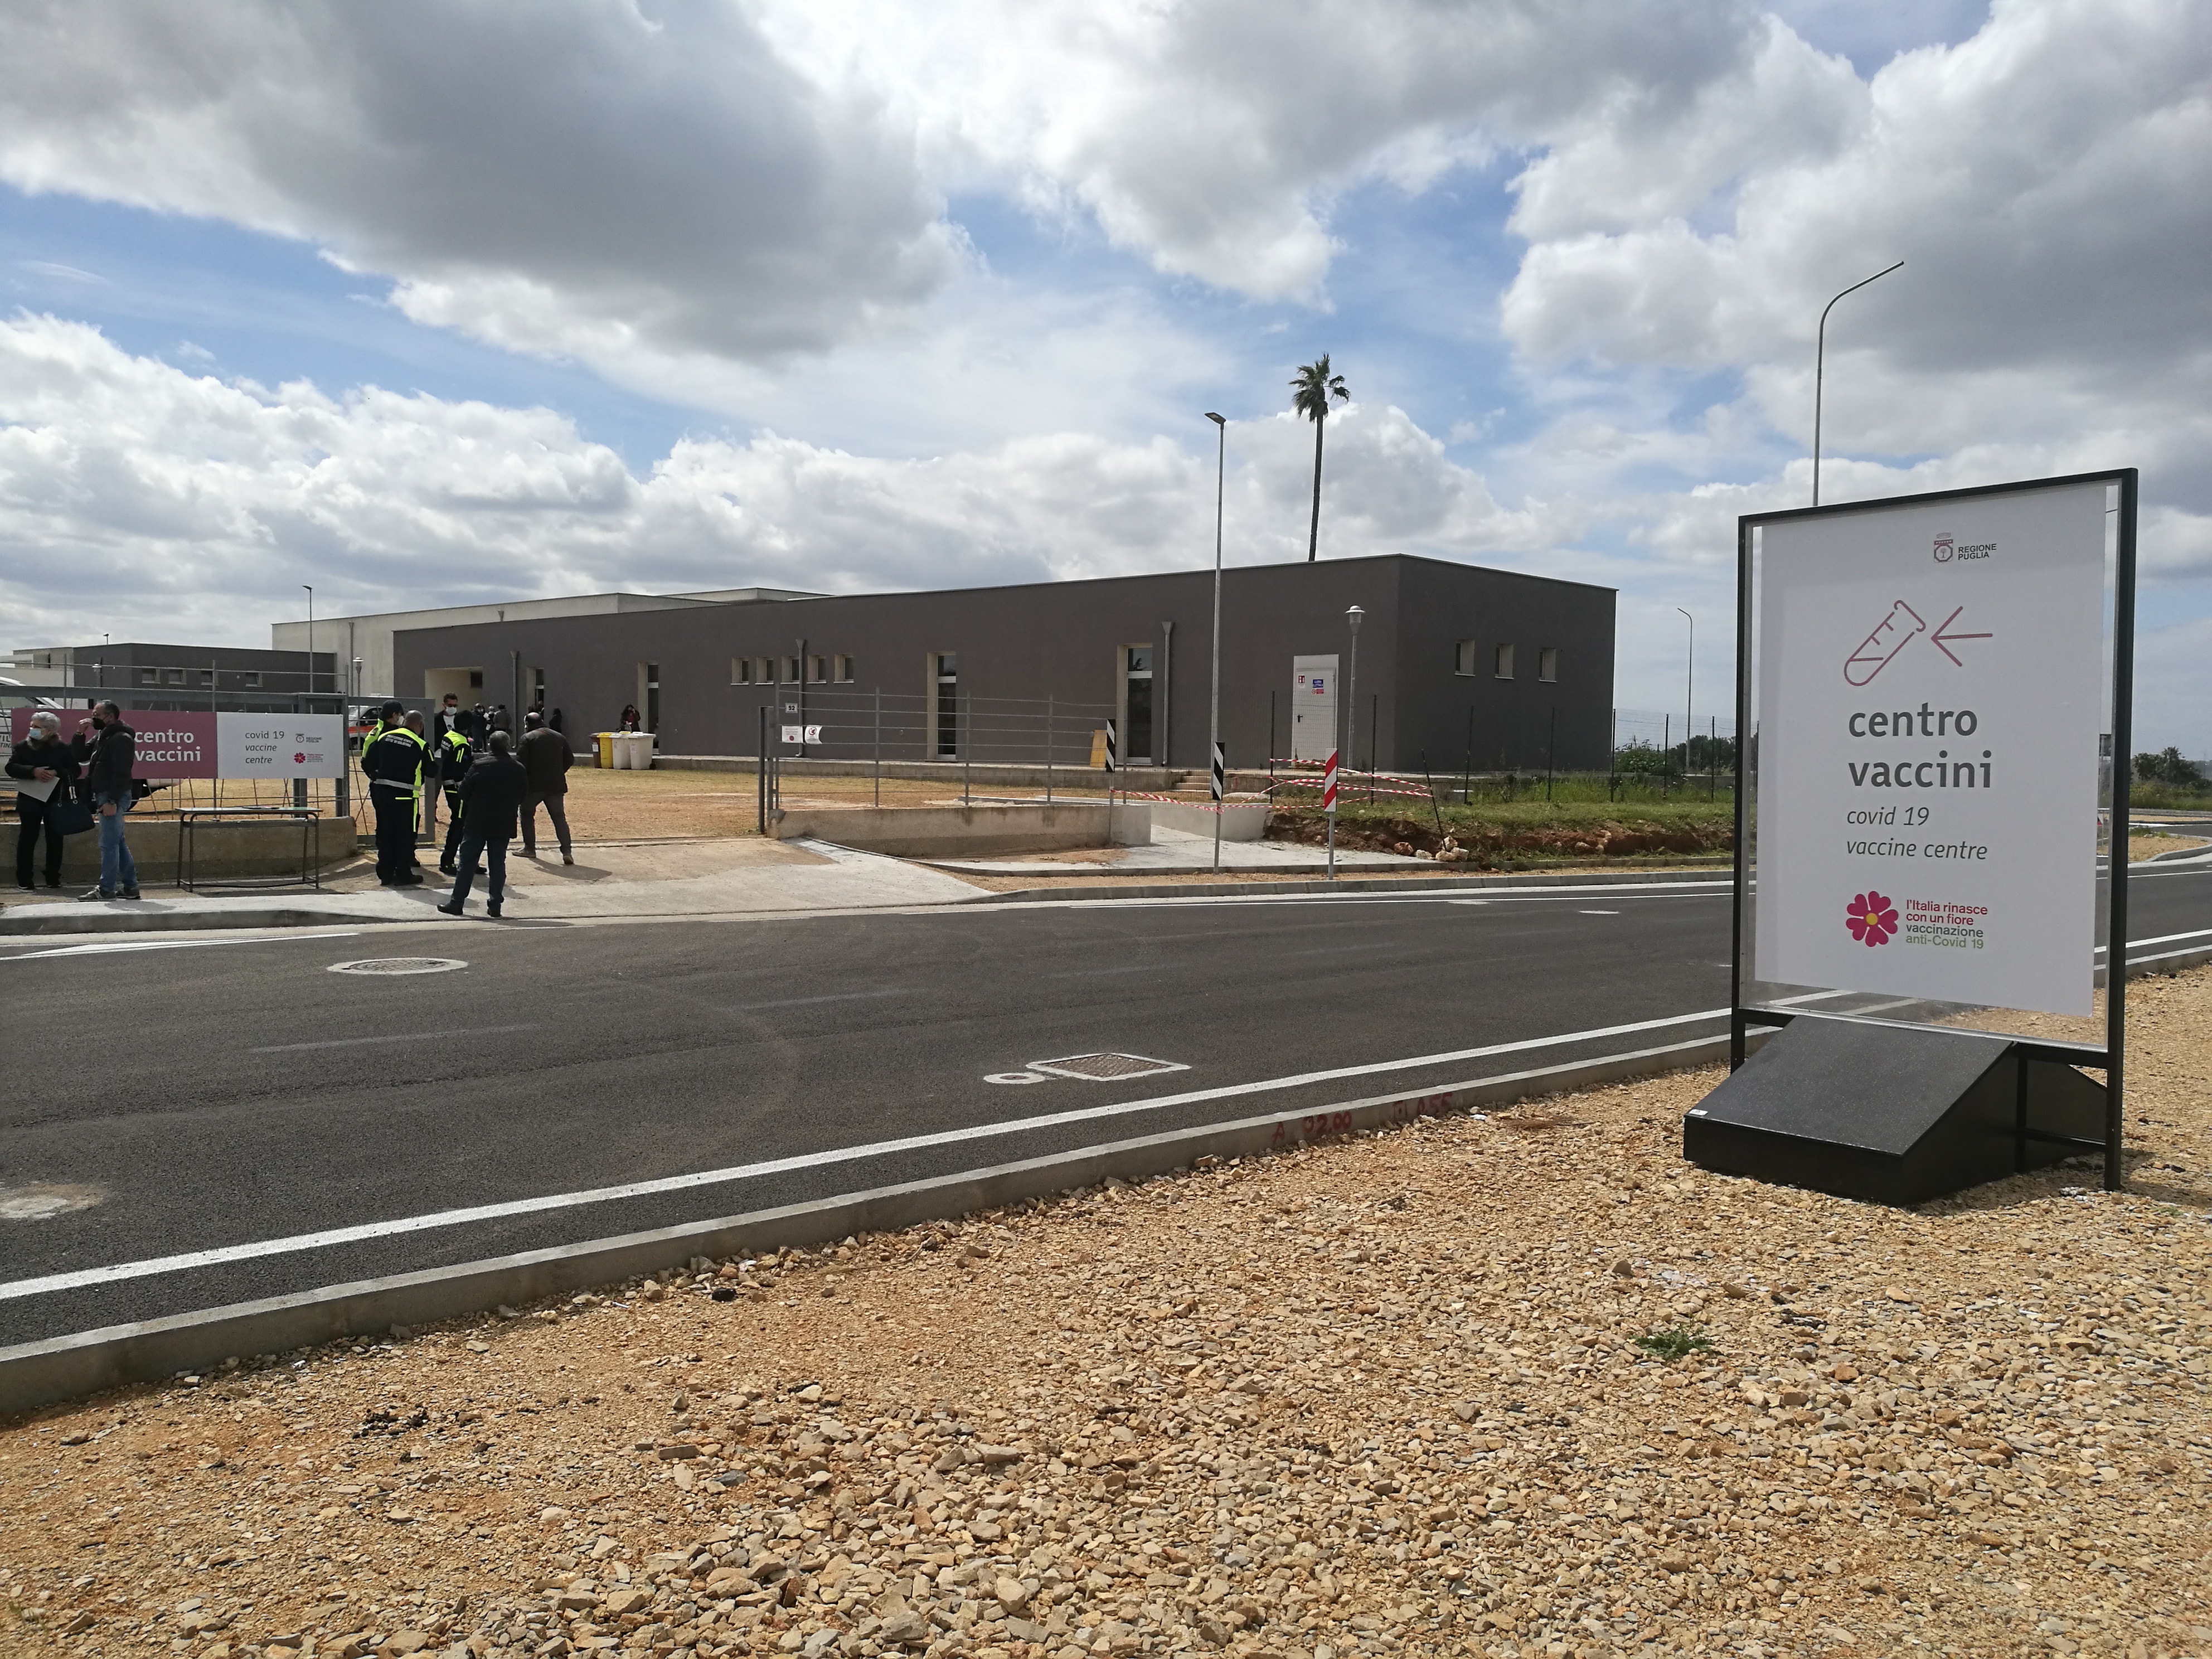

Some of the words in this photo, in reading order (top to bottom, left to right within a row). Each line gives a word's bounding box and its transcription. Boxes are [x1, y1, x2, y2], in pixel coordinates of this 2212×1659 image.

[1958, 544, 1997, 553] REGIONE
[1958, 551, 1990, 560] PUGLIA
[1849, 702, 1977, 737] centro
[134, 729, 194, 743] centro
[273, 731, 284, 739] 19
[135, 746, 201, 761] vaccini
[1848, 750, 1991, 788] vaccini
[1847, 806, 1896, 825] covid
[1904, 807, 1929, 826] 19
[1847, 838, 1917, 857] vaccine
[1924, 841, 1987, 860] centre
[1943, 903, 1987, 915] rinasce
[1906, 913, 1927, 921] con
[1930, 915, 1943, 923] un
[1947, 914, 1973, 925] fiore
[1906, 924, 1983, 938] vaccinazione
[1906, 934, 1966, 948] anti-Covid
[1971, 939, 1983, 949] 19
